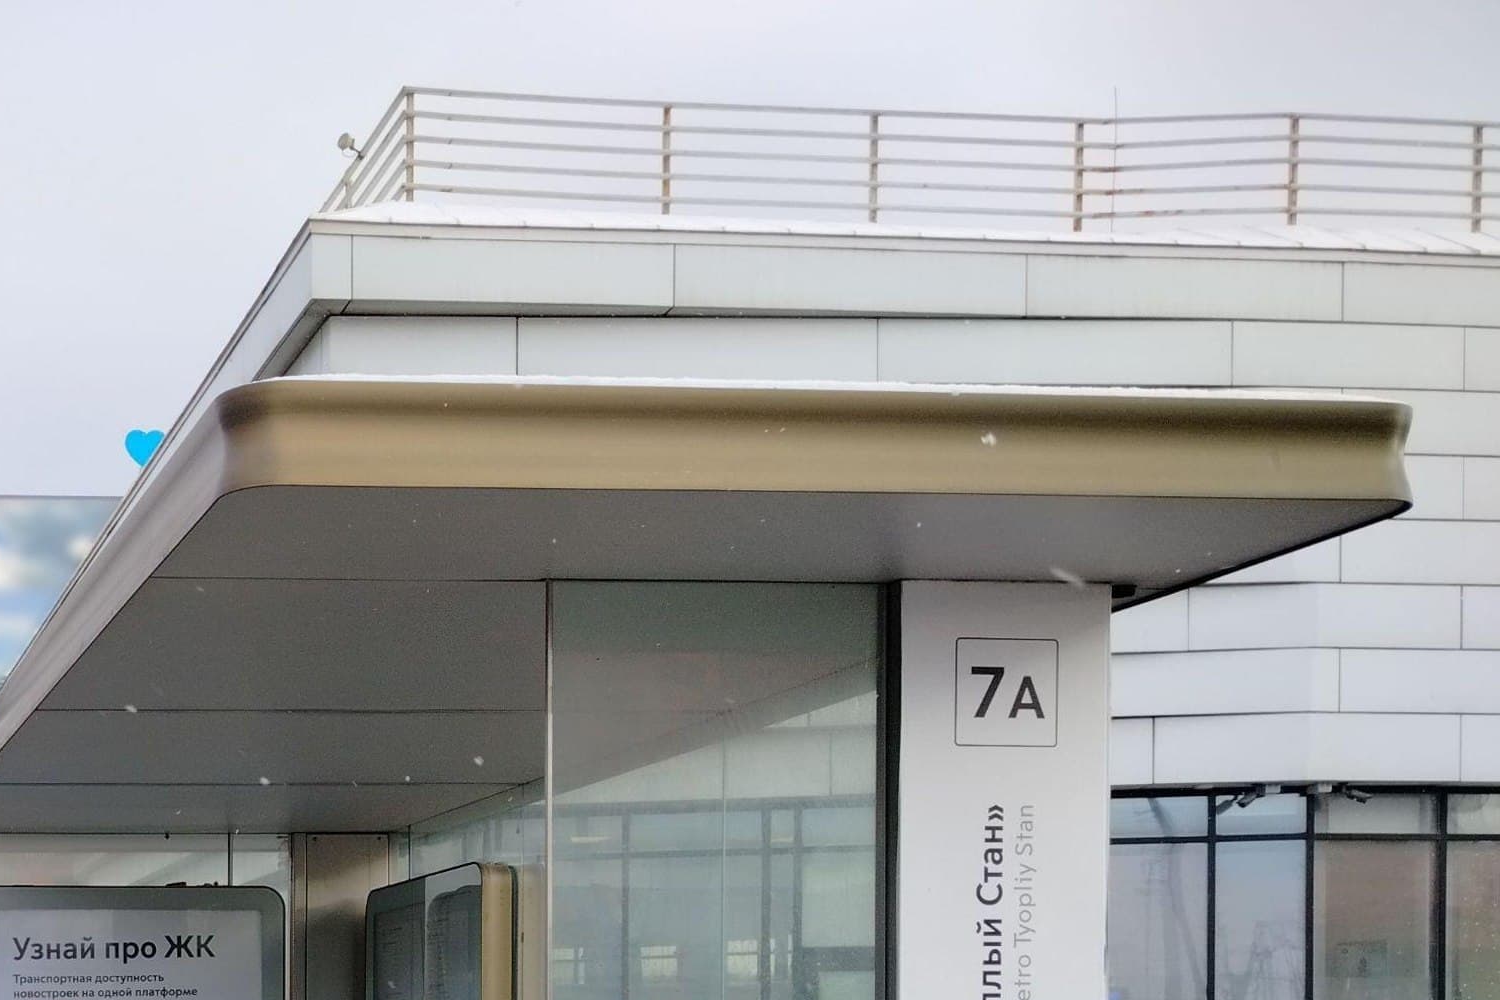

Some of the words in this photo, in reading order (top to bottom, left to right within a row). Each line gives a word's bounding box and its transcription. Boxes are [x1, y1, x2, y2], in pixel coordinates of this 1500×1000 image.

[970, 666, 1045, 719] 7А
[976, 804, 1004, 906] Стан»
[1015, 804, 1034, 856] Stan
[1013, 863, 1037, 948] Tyopliy
[12, 936, 95, 961] Узнай
[105, 941, 157, 964] про
[164, 935, 216, 958] ЖК
[13, 974, 92, 985] Транспортная
[95, 973, 165, 984] доступность
[13, 989, 79, 1000] новостроек
[81, 989, 95, 998] на
[97, 987, 132, 999] одной
[135, 986, 198, 999] платформе
